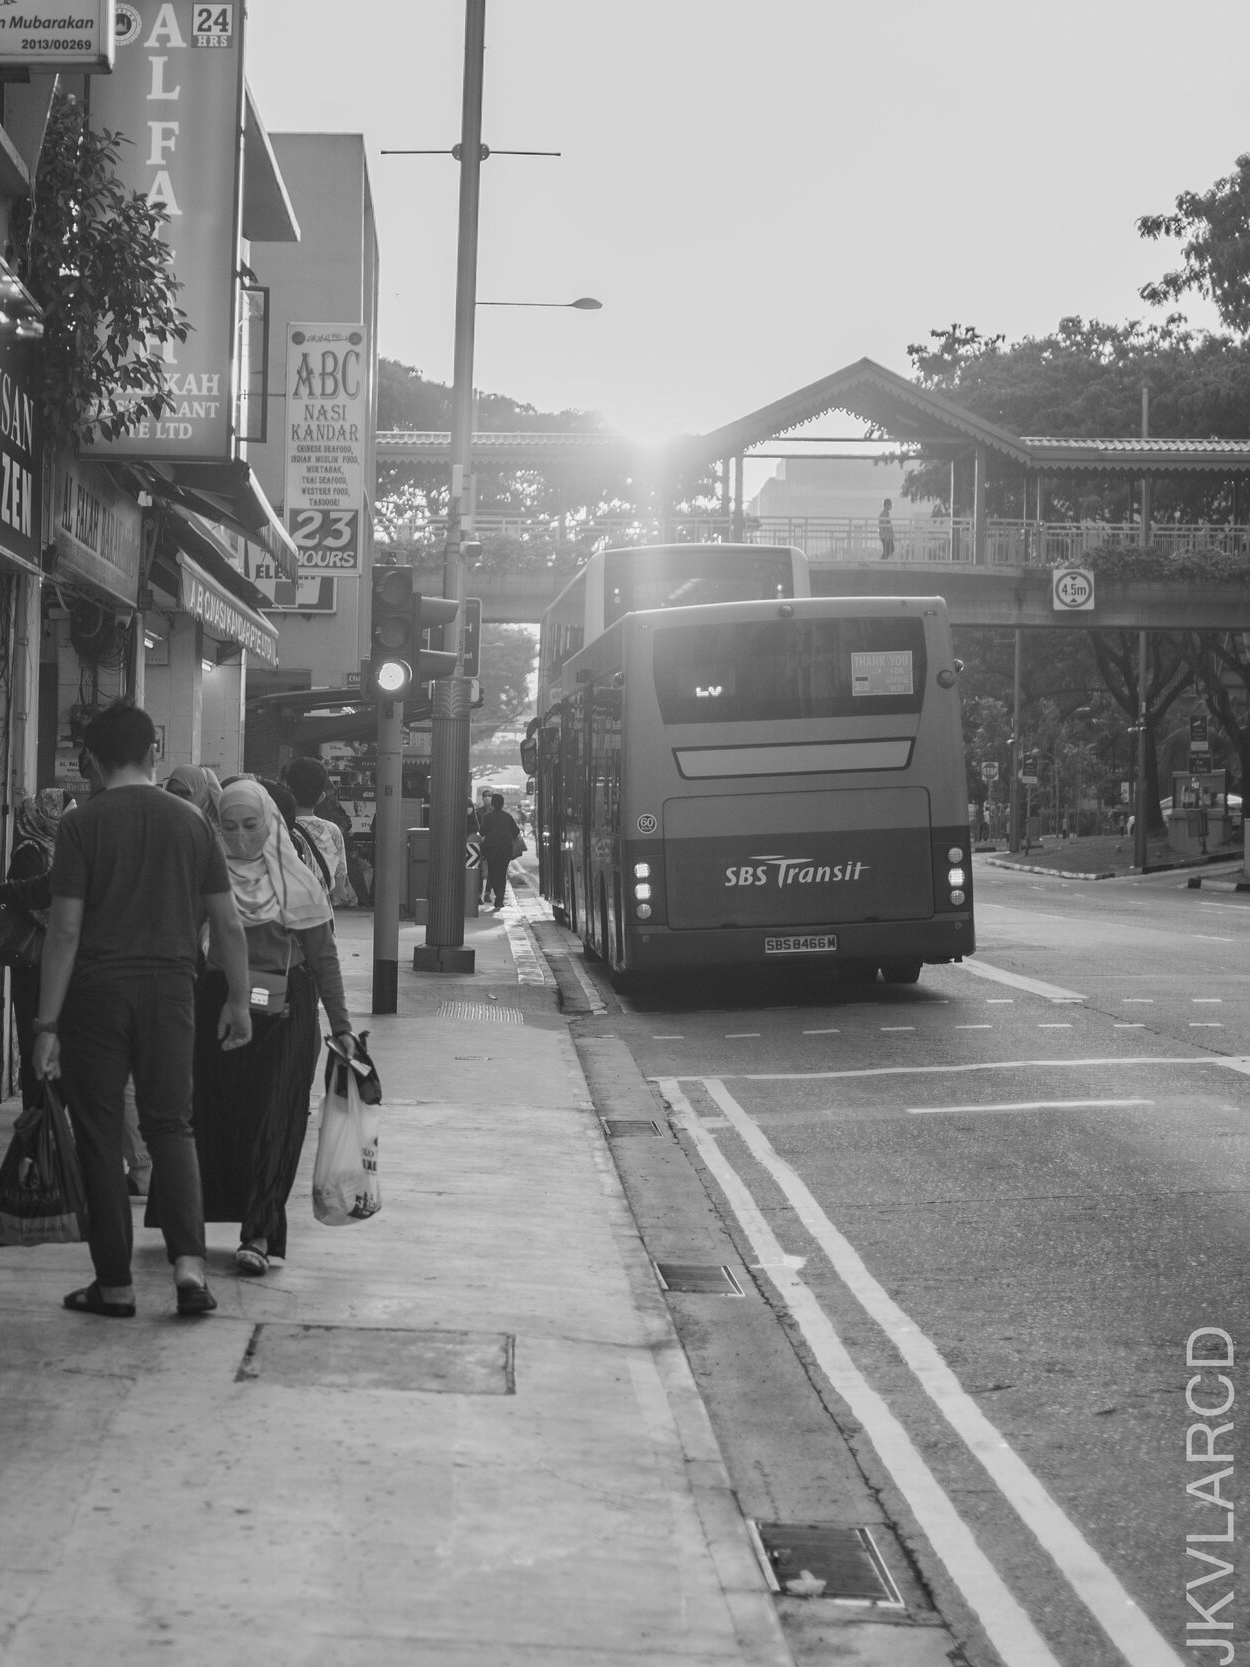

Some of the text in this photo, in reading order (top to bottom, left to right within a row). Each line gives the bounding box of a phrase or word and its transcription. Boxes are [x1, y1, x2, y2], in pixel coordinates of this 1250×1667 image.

[9, 15, 93, 29] Mubarakan
[197, 8, 229, 32] 24
[21, 39, 92, 50] 2013/00269
[197, 35, 228, 47] HRS
[292, 350, 360, 399] ABC
[304, 404, 347, 421] NASI
[155, 422, 193, 439] LTD
[291, 423, 359, 441] KANDAR
[291, 455, 311, 463] INDIAN
[315, 455, 338, 463] MUSLIM
[302, 476, 317, 484] THAI
[302, 487, 331, 495] WESTERN
[291, 510, 356, 548] 23
[1061, 583, 1087, 596] 4.5m
[854, 655, 909, 667] THANK YOU
[640, 817, 654, 827] 60
[724, 858, 871, 888] SBS Transit
[766, 937, 836, 951] SBS8466M
